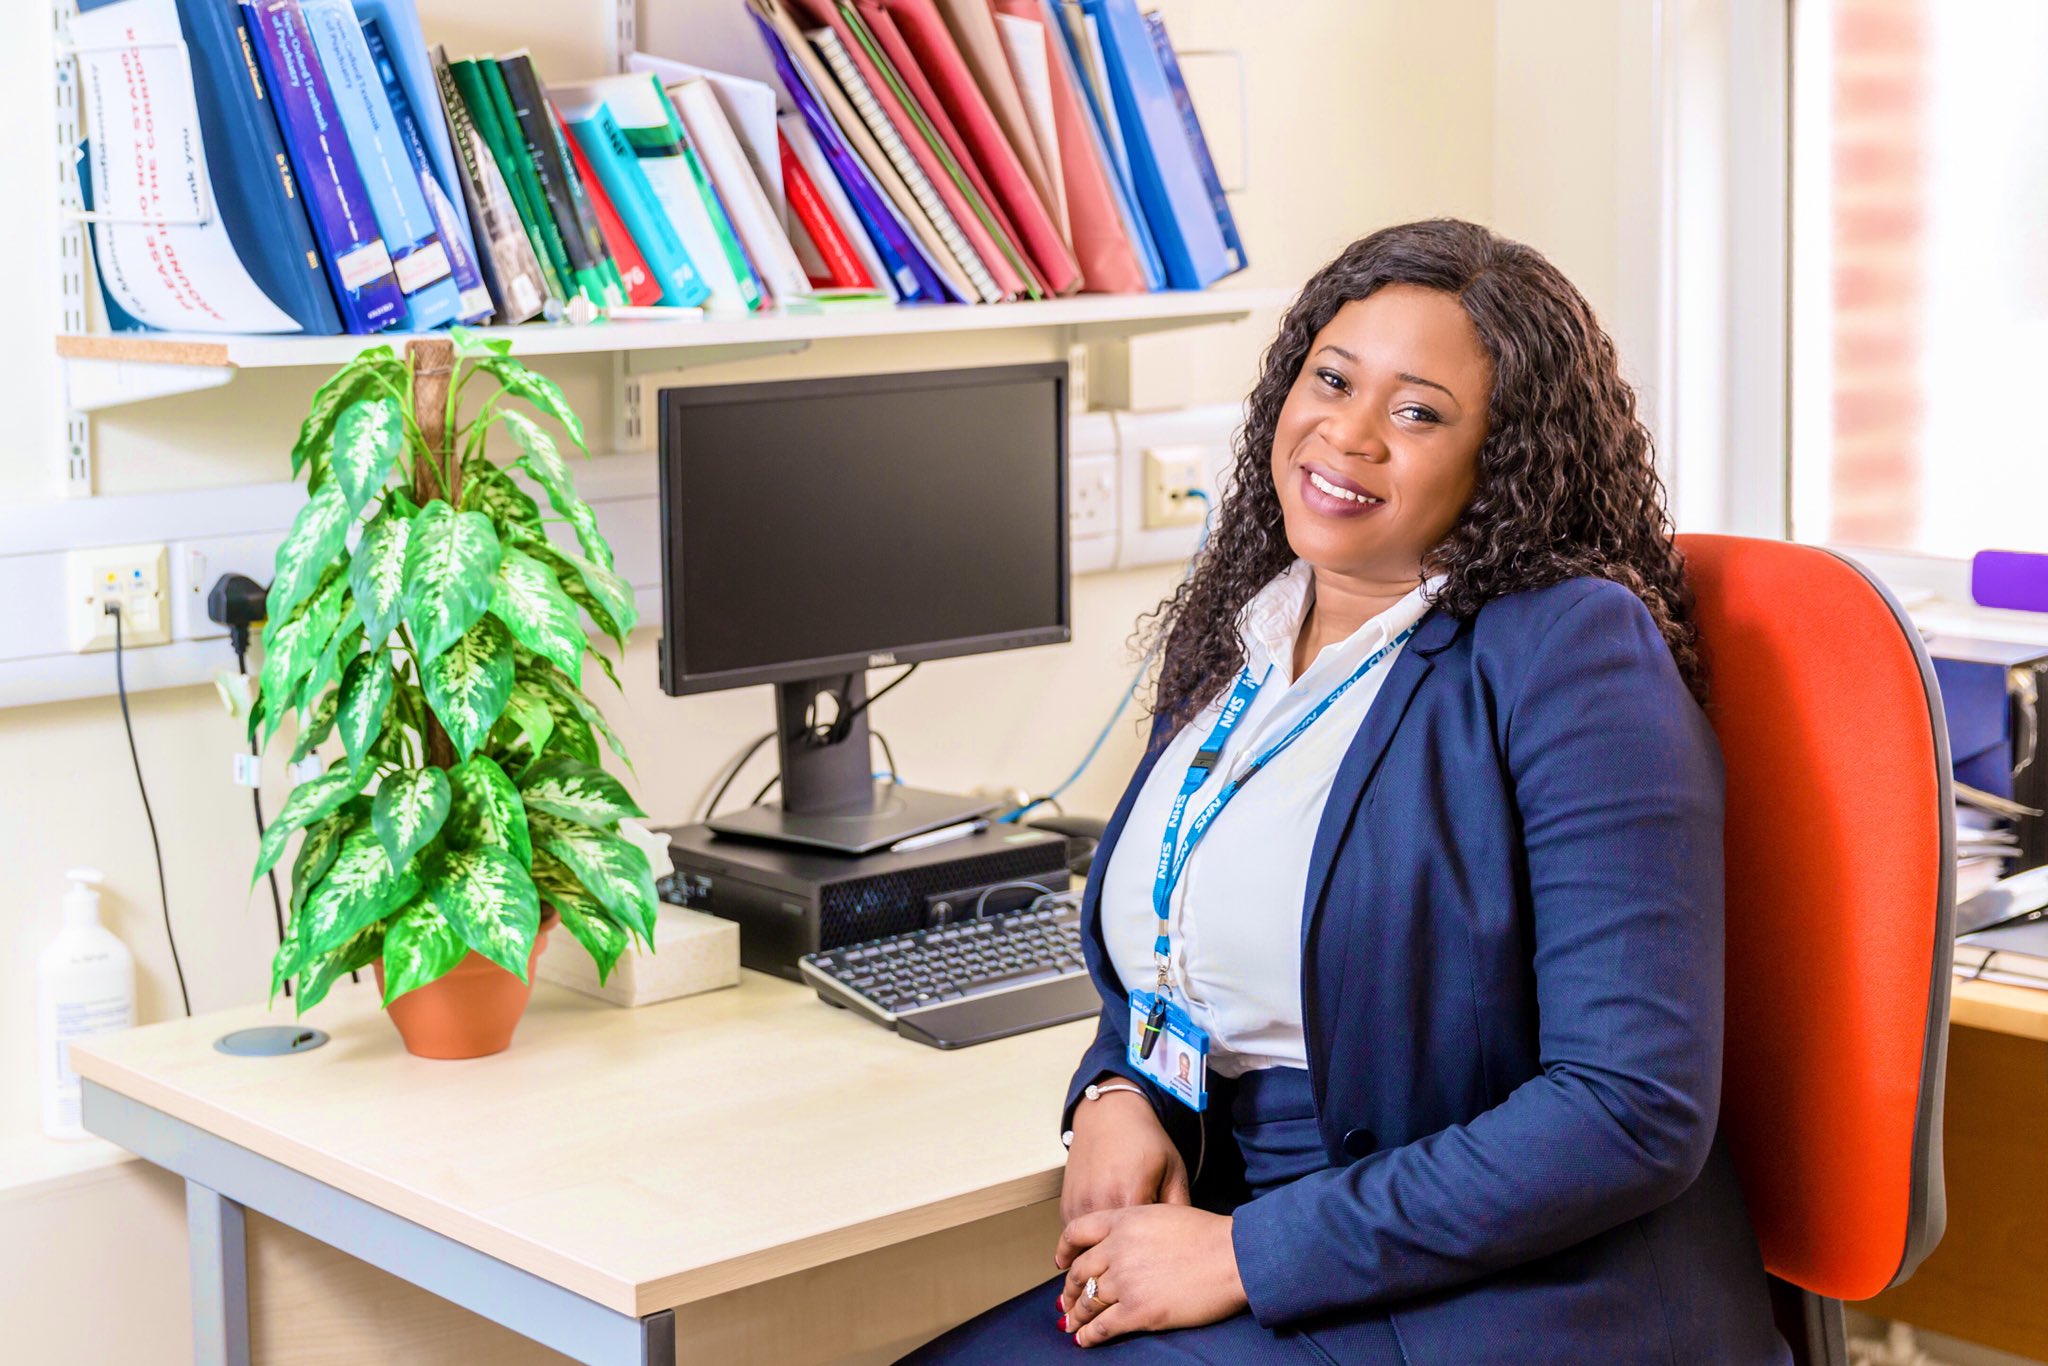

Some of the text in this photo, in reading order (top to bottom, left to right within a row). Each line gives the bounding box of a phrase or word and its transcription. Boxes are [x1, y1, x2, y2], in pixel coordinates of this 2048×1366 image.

[276, 28, 301, 88] Psychiatry
[121, 52, 141, 131] STAND
[291, 37, 311, 79] Oxford
[304, 79, 328, 132] Textbook
[603, 119, 625, 157] BNF
[134, 138, 146, 187] NOT
[148, 157, 161, 205] THE
[182, 127, 208, 230] Tank you
[1219, 695, 1246, 729] NHS
[1168, 793, 1188, 828] NHS
[1194, 797, 1222, 833] NHS
[1157, 841, 1173, 879] NHS
